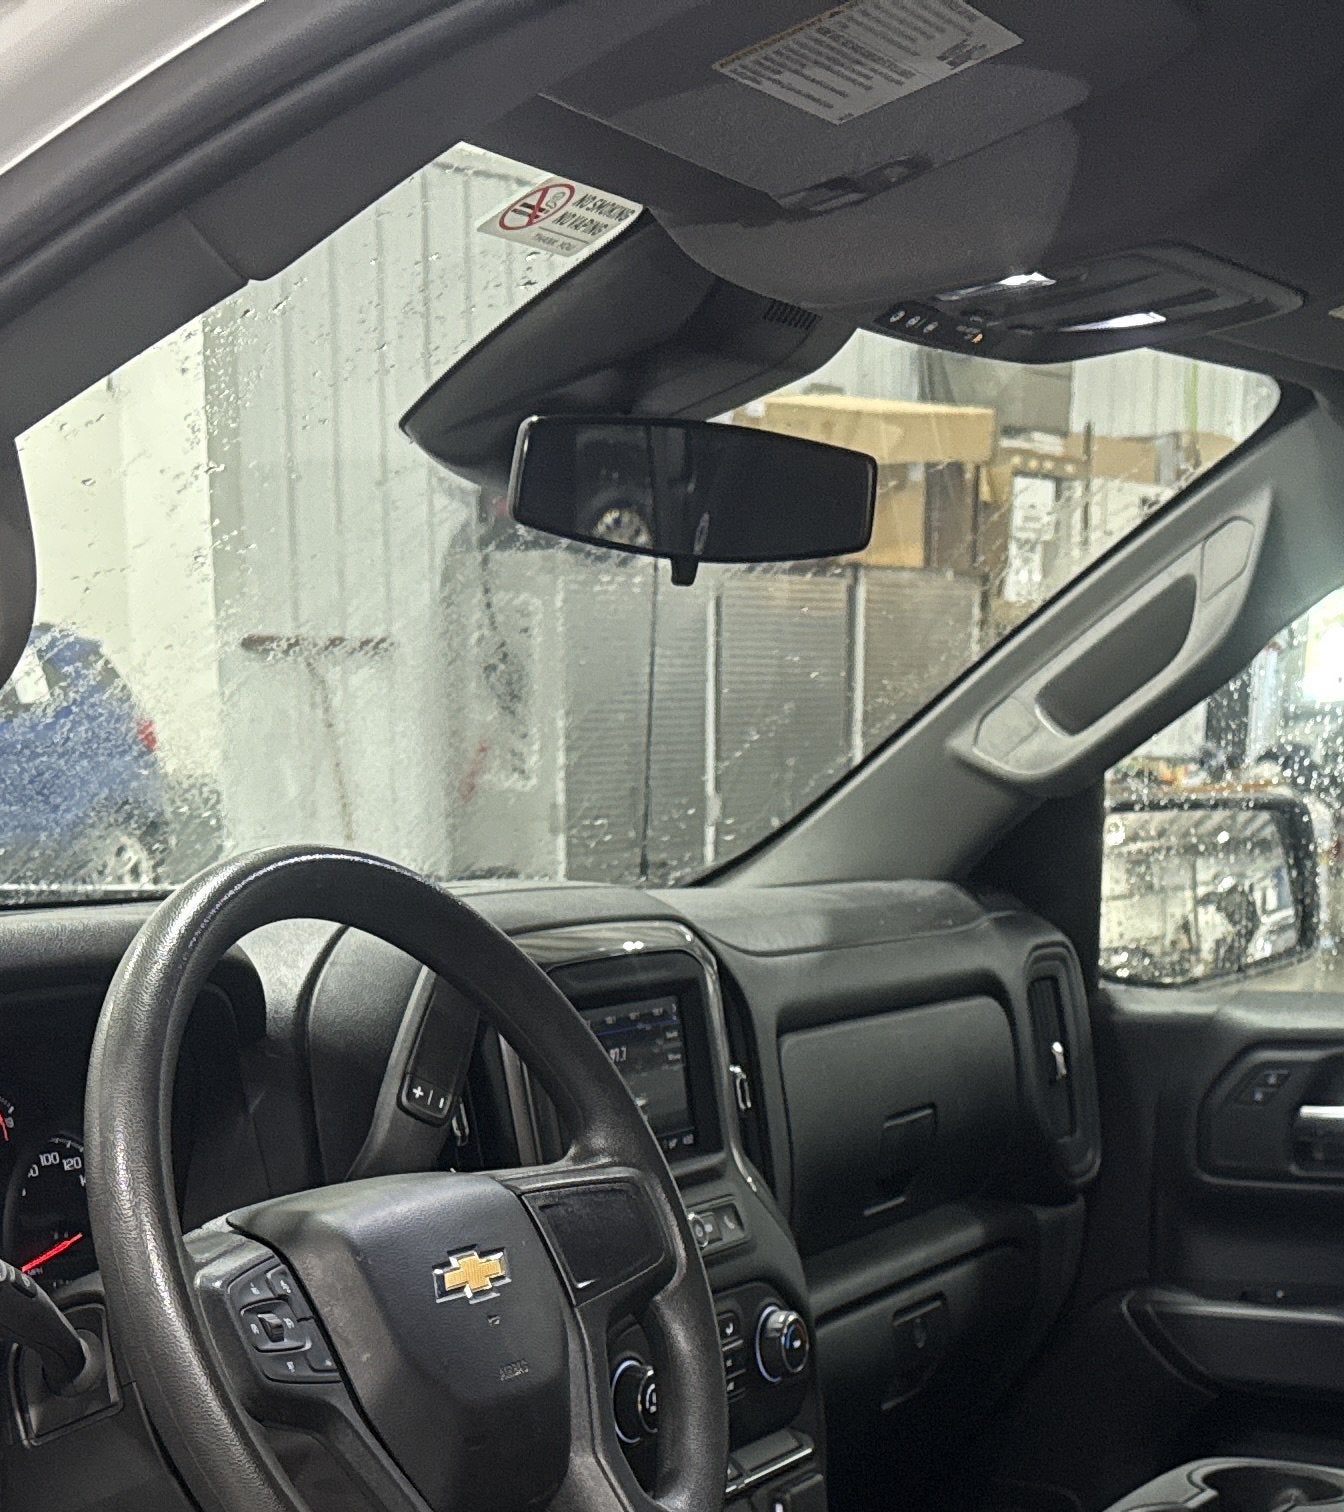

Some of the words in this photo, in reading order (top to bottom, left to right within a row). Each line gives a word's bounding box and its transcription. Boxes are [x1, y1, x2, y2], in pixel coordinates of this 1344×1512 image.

[572, 193, 597, 209] NO
[585, 198, 636, 222] SMOKING
[552, 211, 577, 226] NO
[567, 215, 609, 236] VAPING
[38, 1151, 60, 1167] 100
[61, 1156, 83, 1171] 120
